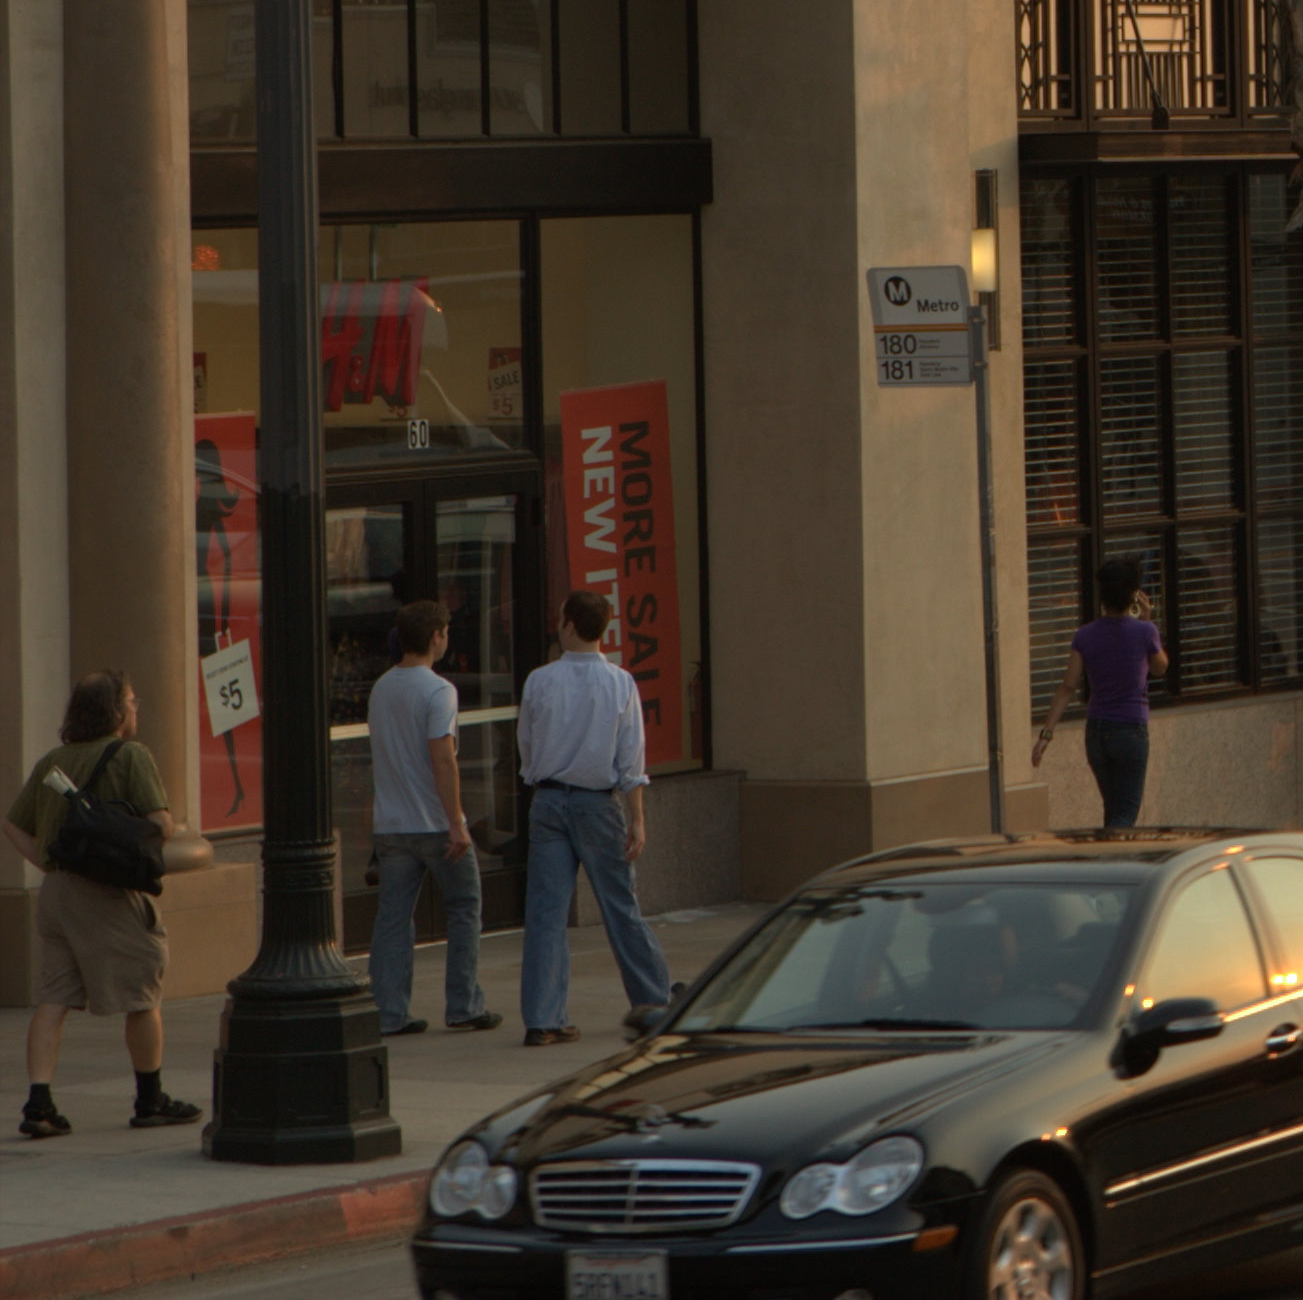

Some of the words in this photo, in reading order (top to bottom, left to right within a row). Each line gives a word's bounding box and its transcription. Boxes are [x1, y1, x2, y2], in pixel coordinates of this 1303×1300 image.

[917, 299, 959, 313] Metro
[880, 334, 917, 355] 180
[493, 371, 520, 391] SALE
[881, 360, 914, 380] 181
[492, 397, 513, 416] $5
[409, 421, 428, 448] 60
[580, 425, 618, 554] NEW
[618, 420, 657, 579] MORE
[626, 593, 662, 727] SALE
[219, 678, 243, 710] $5
